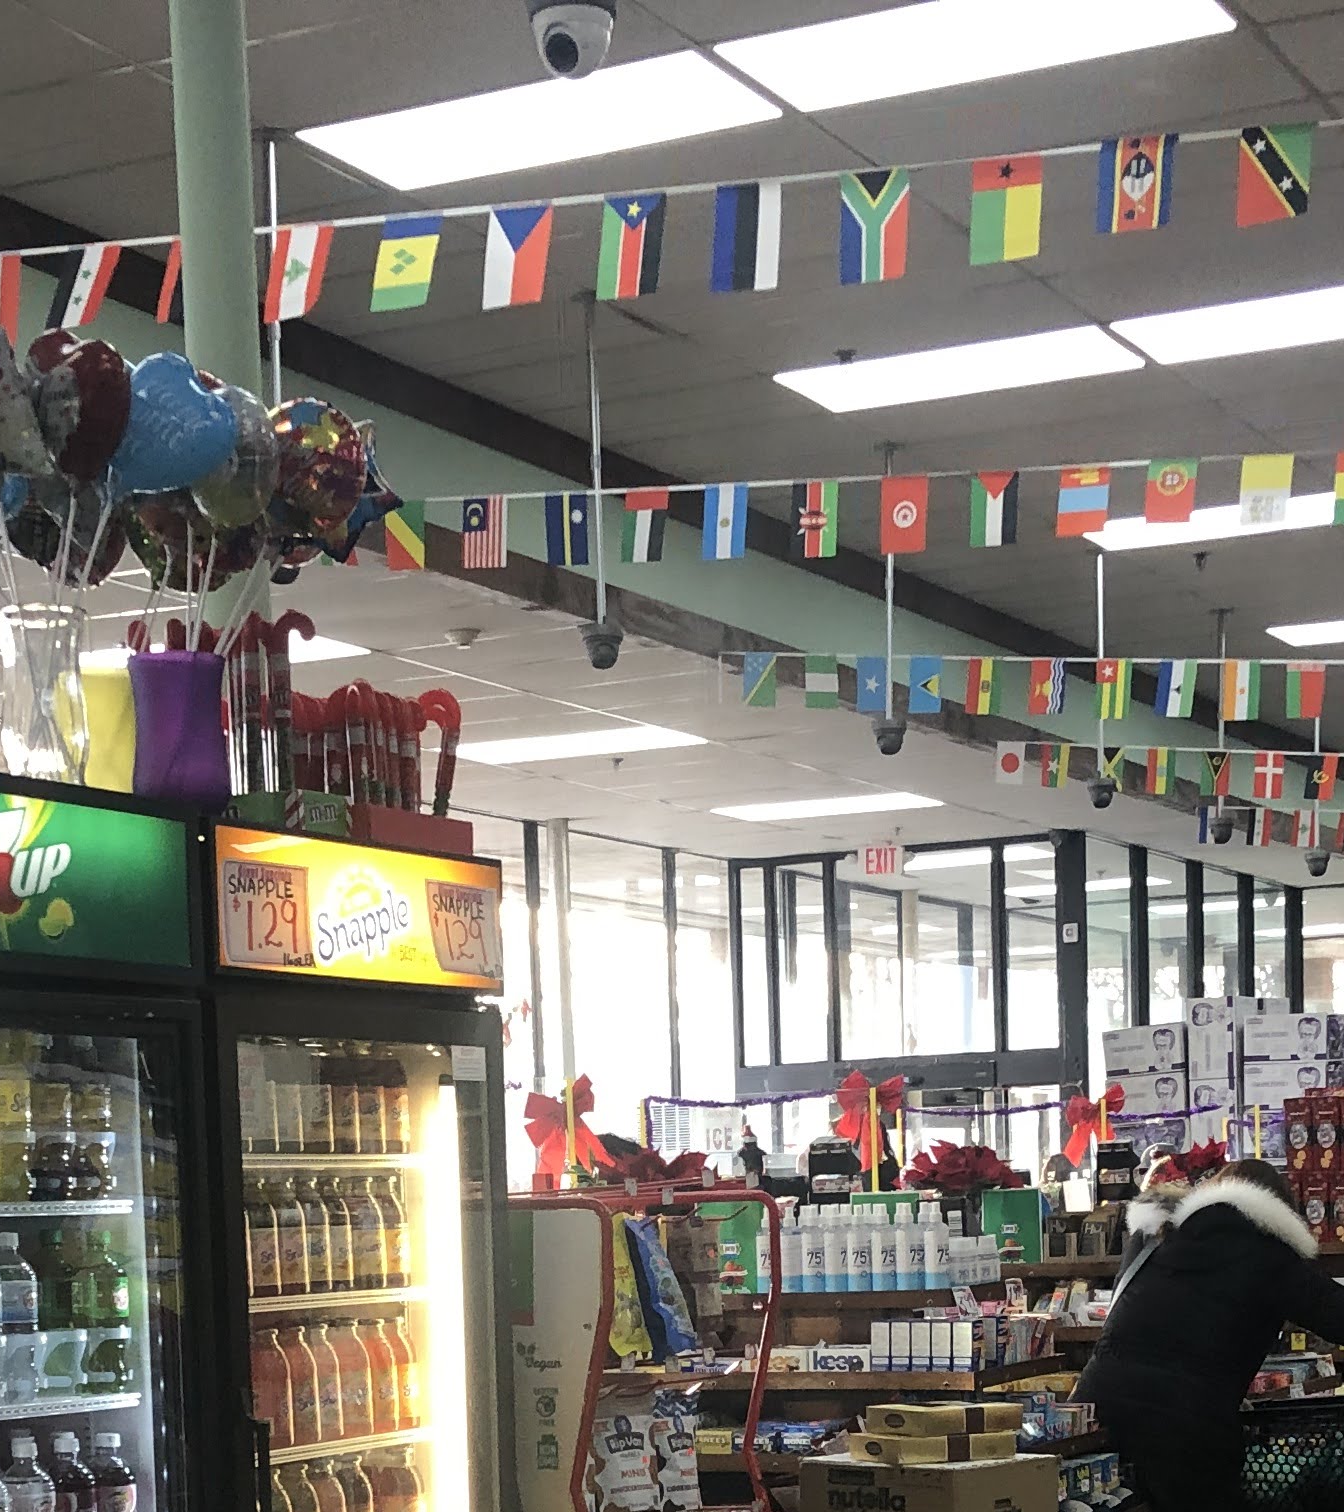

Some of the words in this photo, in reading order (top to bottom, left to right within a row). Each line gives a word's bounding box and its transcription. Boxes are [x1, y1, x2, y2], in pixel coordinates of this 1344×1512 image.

[865, 847, 897, 875] EXIT
[228, 873, 293, 899] SNAPPLE
[432, 893, 485, 920] SNAPPLE
[317, 889, 408, 961] Snapple
[705, 1127, 733, 1151] ICE
[813, 1351, 864, 1372] keep
[828, 1486, 906, 1512] nutella
